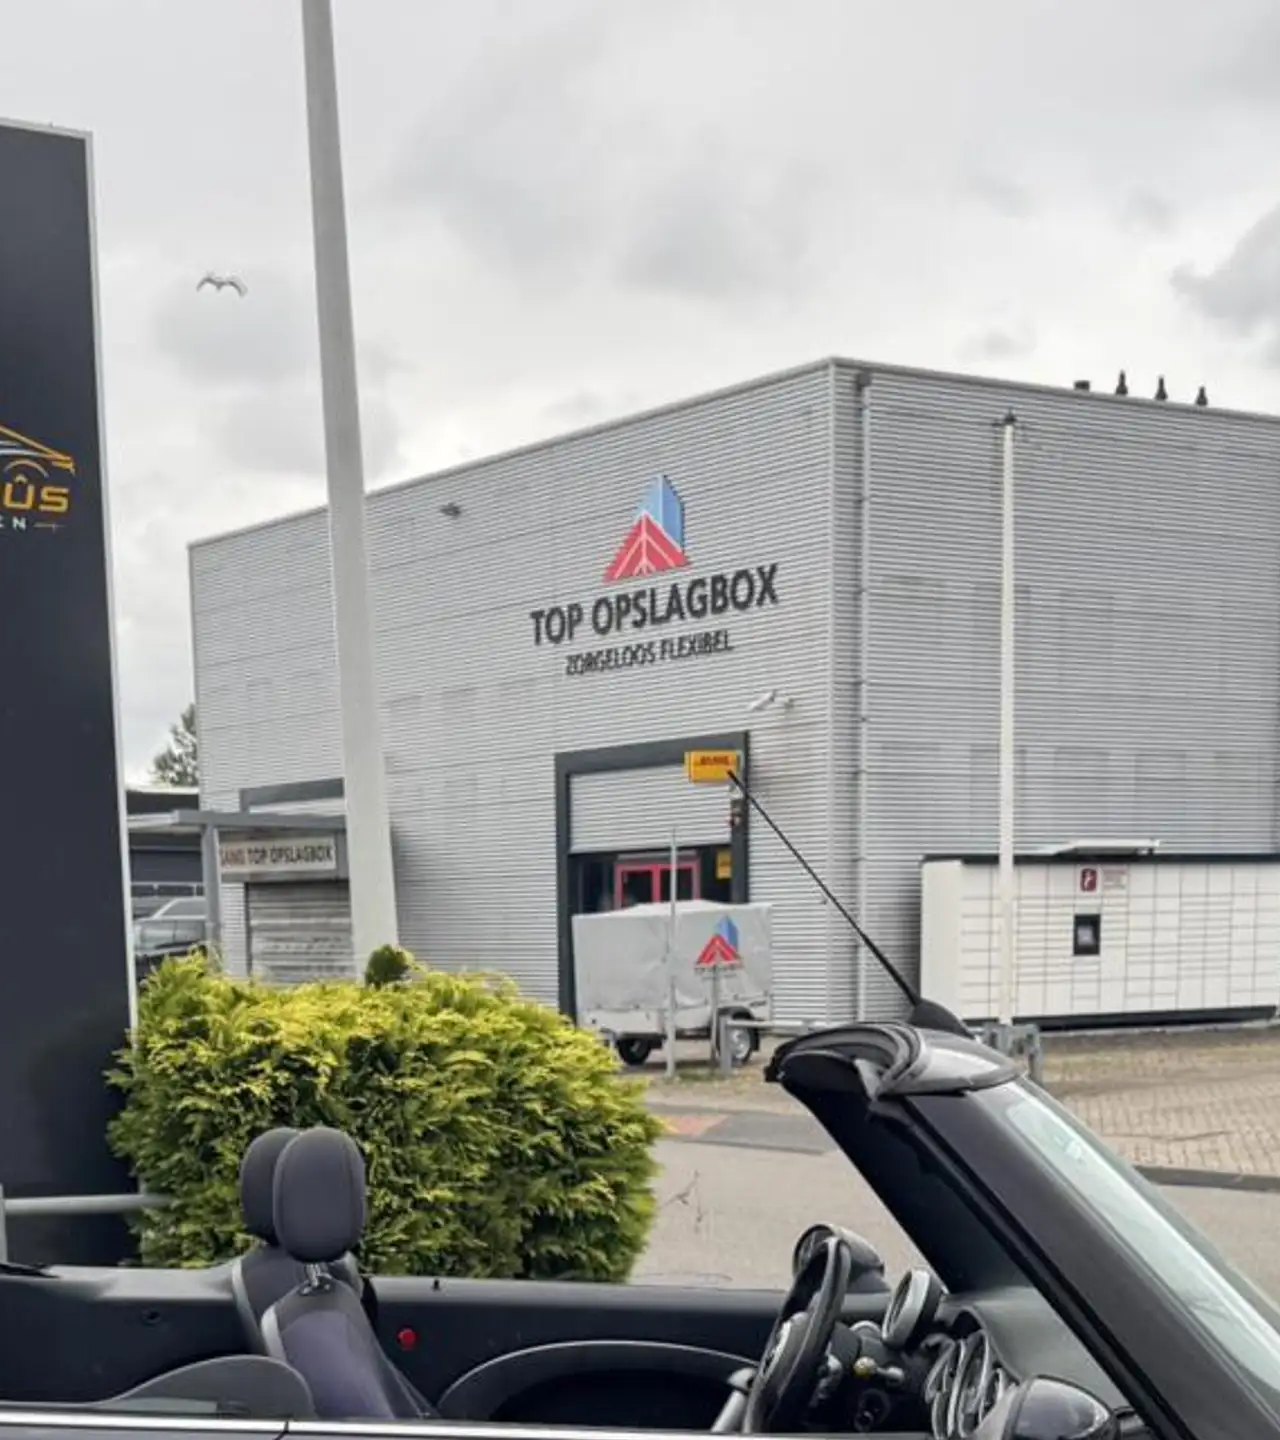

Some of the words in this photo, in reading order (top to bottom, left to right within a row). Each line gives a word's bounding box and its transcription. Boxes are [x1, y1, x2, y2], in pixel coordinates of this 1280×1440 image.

[529, 603, 584, 646] TOP
[591, 563, 779, 636] OPSLAGBOX
[566, 640, 655, 676] ZORGELOOS
[660, 629, 734, 661] FLEXIBEL
